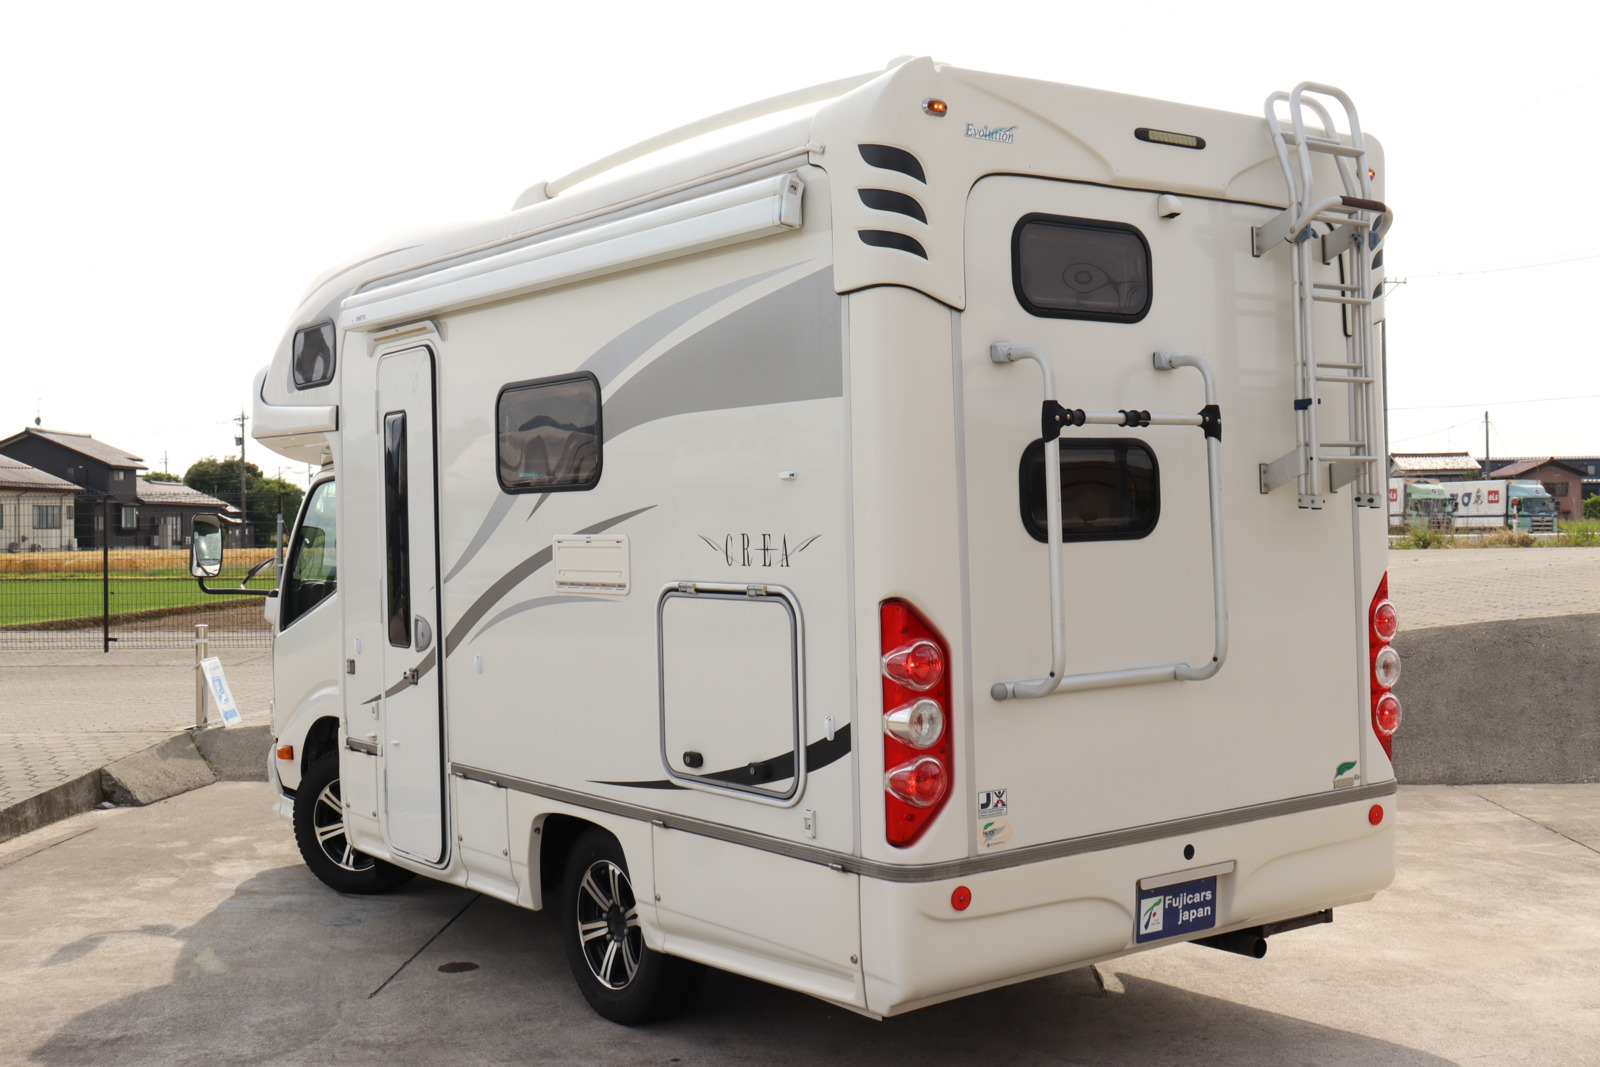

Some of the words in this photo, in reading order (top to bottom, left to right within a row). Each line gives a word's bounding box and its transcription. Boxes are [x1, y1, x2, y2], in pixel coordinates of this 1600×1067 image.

[964, 122, 1015, 143] Evolution
[725, 533, 791, 567] CREA
[1165, 890, 1212, 909] Fujicars
[1178, 906, 1211, 925] japan
